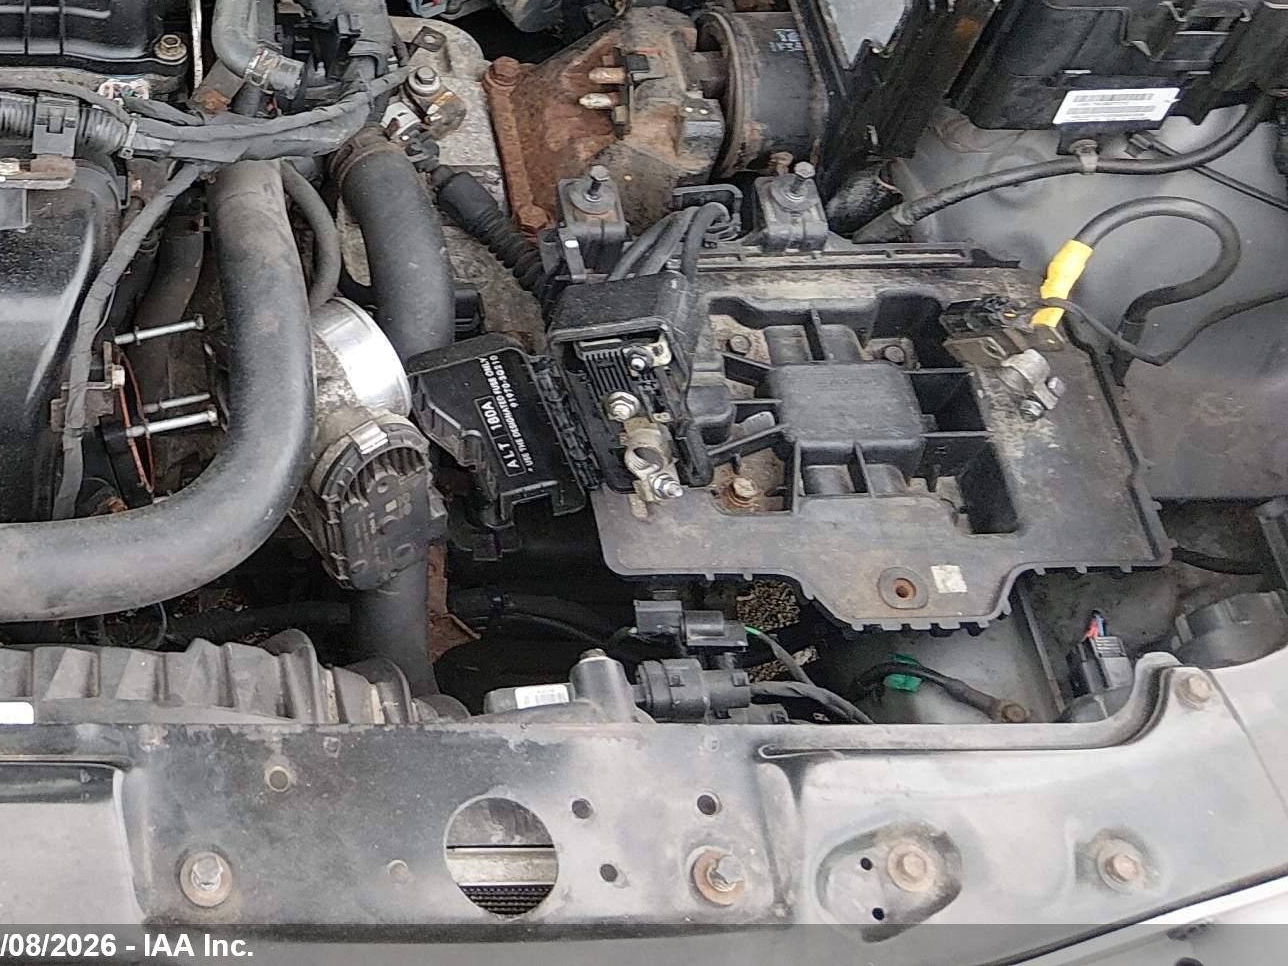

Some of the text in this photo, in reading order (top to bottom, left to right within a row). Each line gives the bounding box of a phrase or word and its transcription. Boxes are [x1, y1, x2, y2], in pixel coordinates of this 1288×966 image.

[480, 357, 534, 467] USE THE DESIGNATED FUSE ONLY
[481, 400, 521, 469] ALT 180A
